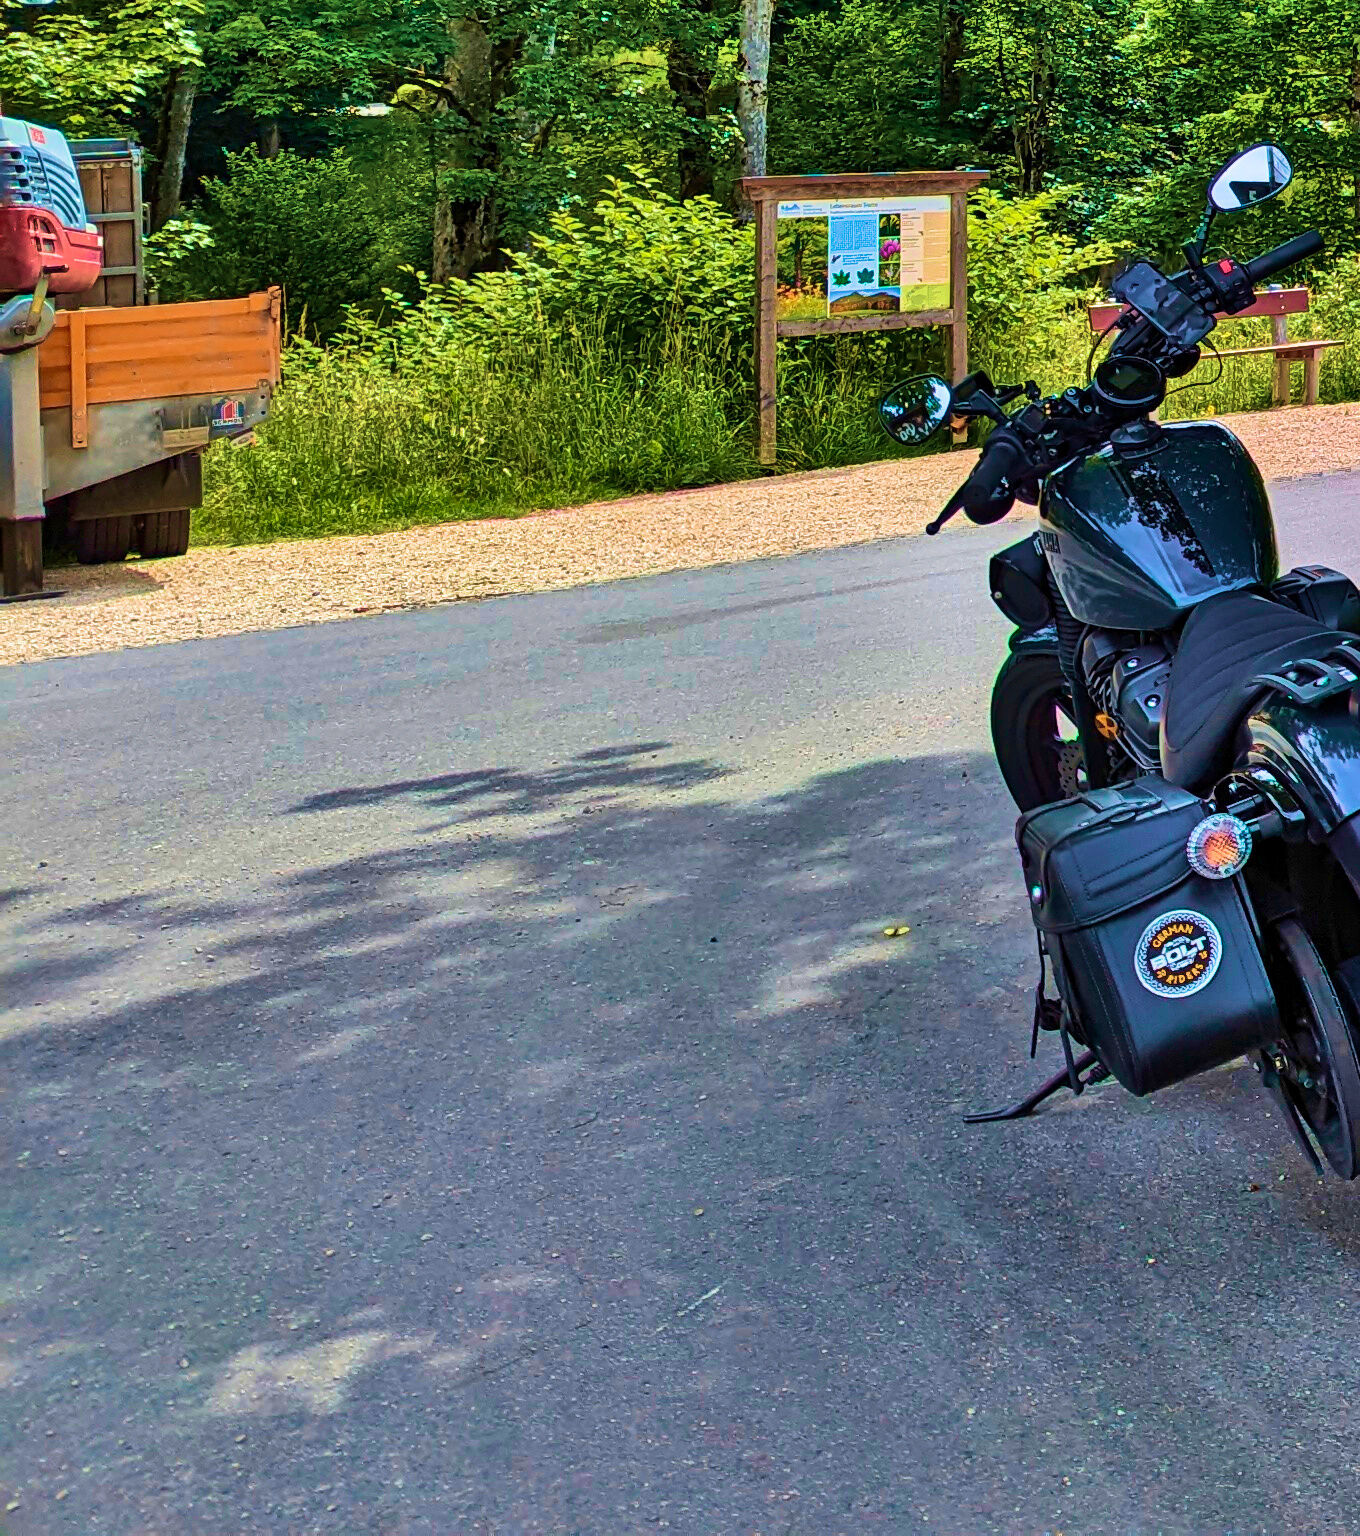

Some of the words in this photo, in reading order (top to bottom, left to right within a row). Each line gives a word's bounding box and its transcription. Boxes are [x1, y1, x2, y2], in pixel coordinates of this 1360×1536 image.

[1152, 923, 1194, 948] GERMAN
[1150, 936, 1207, 971] BOLT
[1165, 963, 1204, 985] RIDERS
